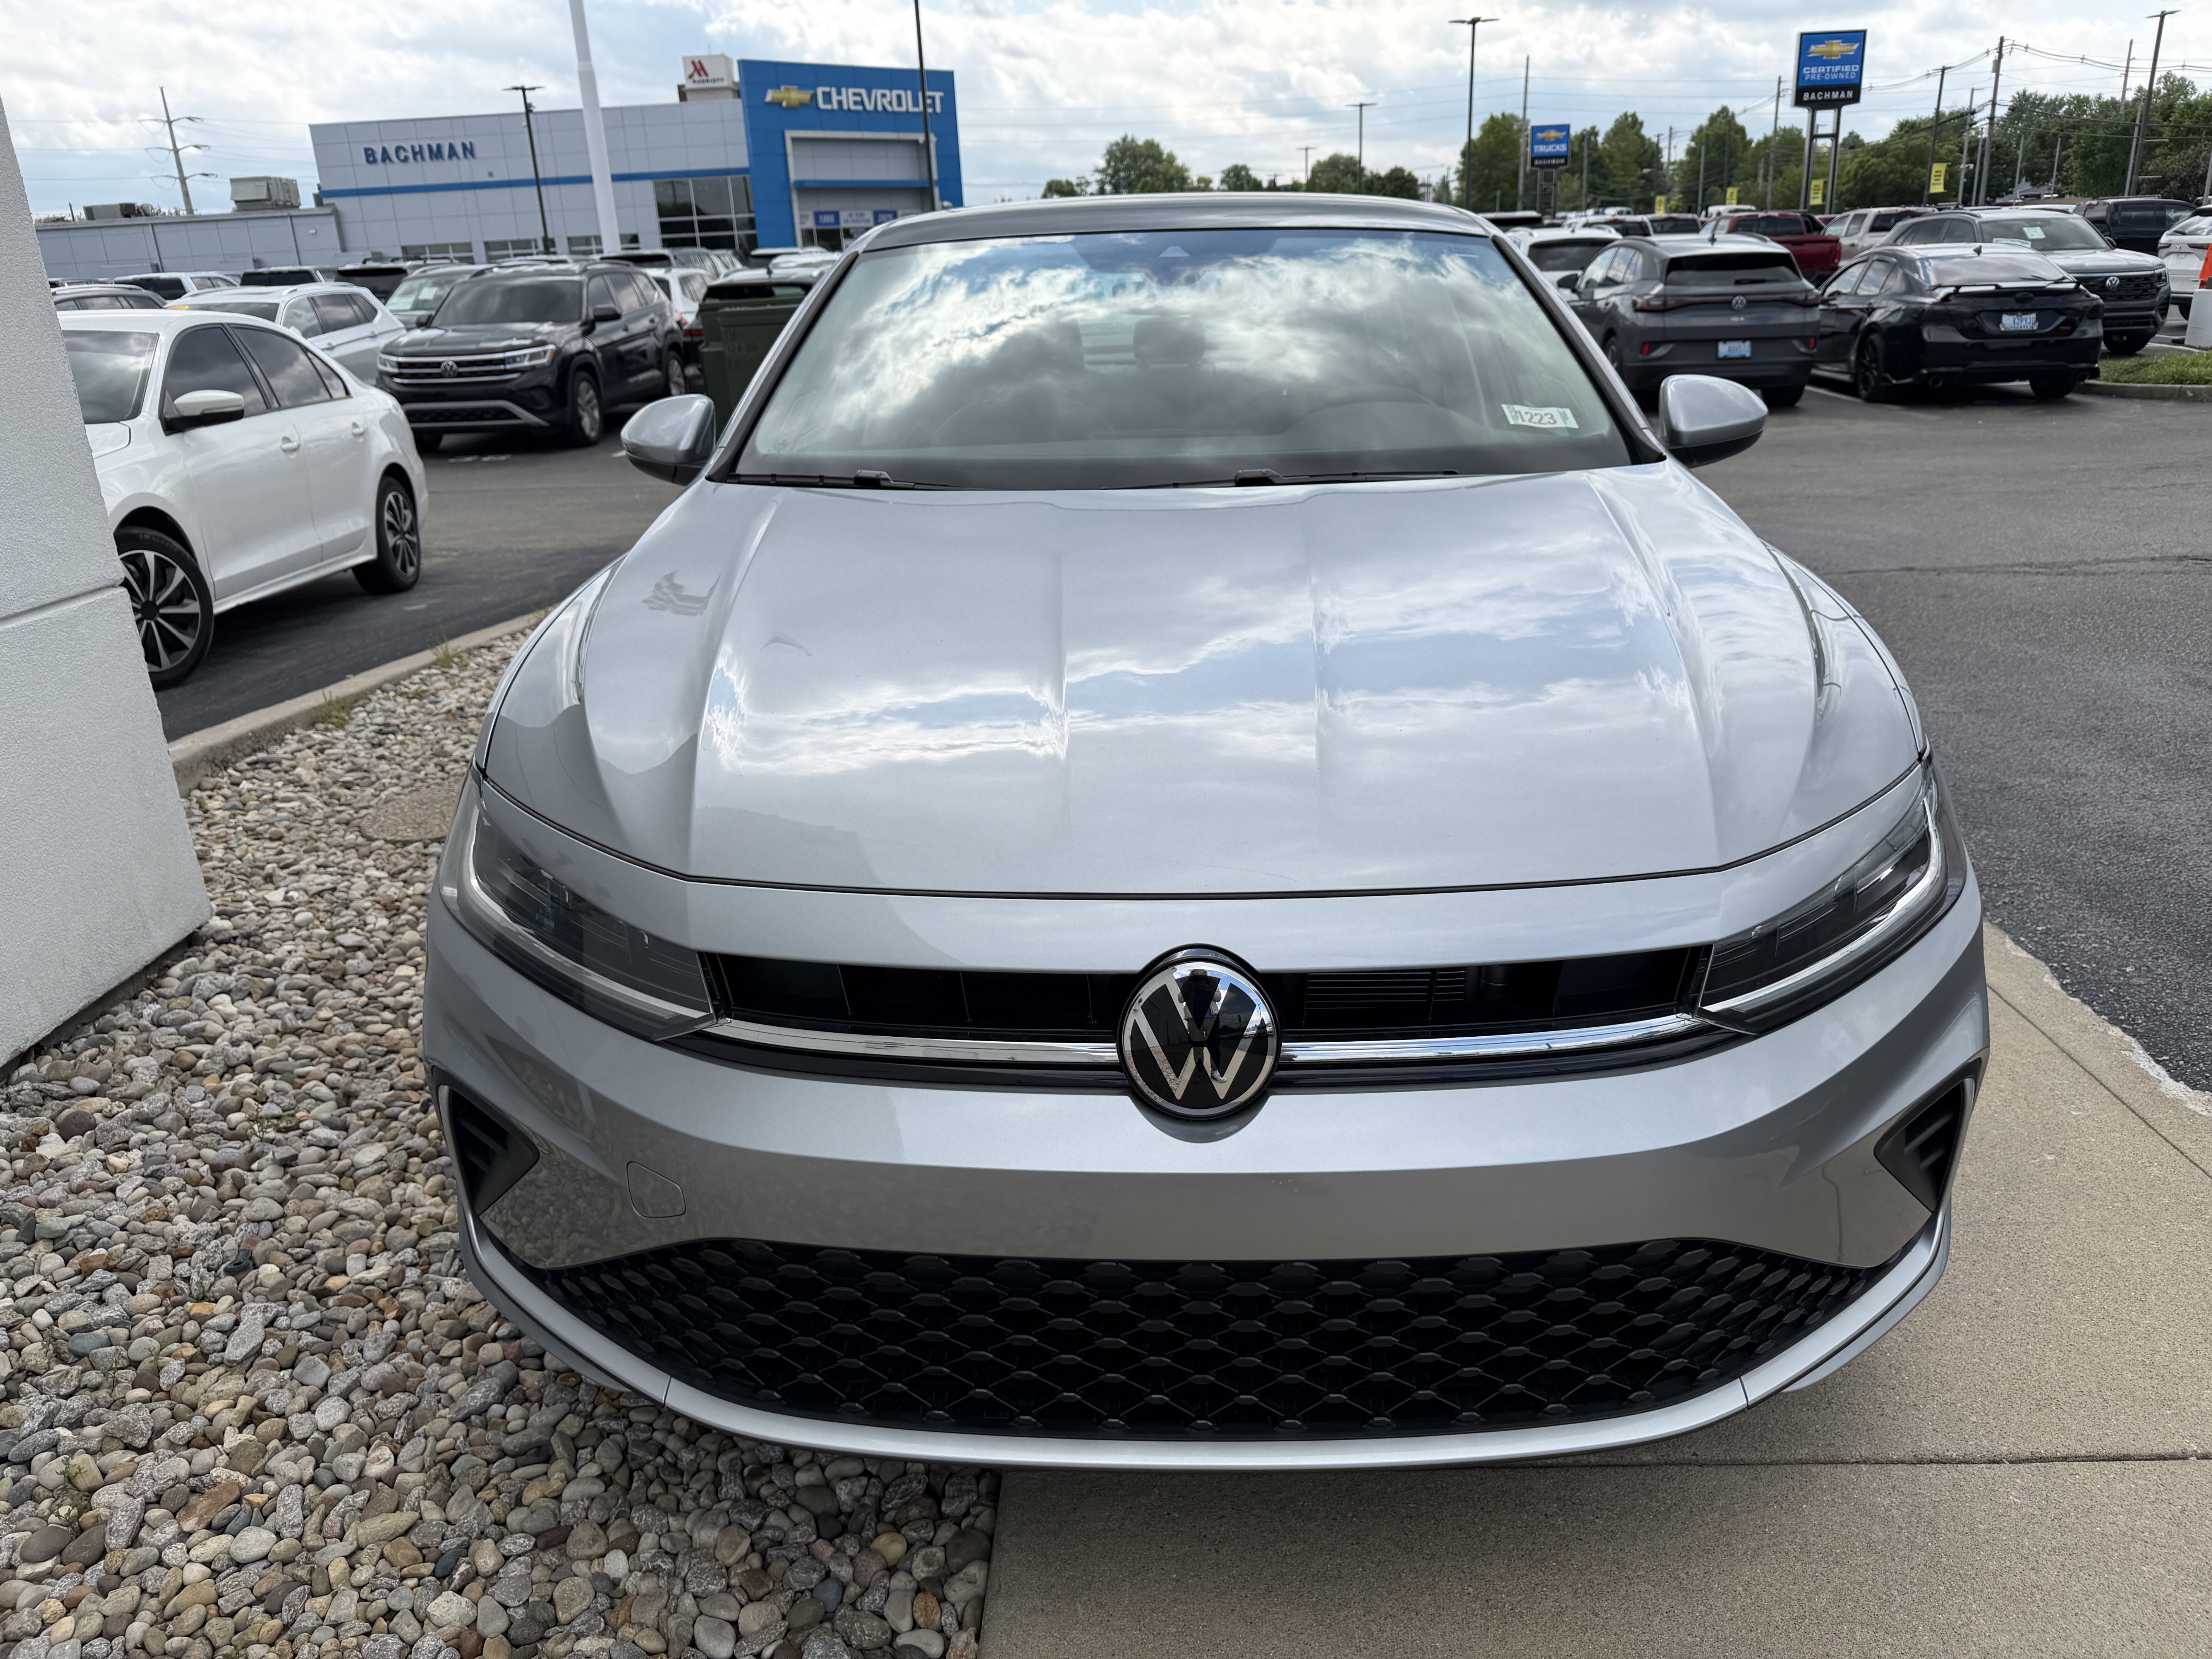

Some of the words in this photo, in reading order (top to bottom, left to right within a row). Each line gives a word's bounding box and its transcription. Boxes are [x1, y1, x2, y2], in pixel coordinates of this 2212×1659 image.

[1803, 64, 1859, 74] CERTIFIED
[1805, 72, 1856, 80] PRE-OWNED
[816, 86, 944, 113] CHEVROLET
[1803, 90, 1853, 101] BACHMAN
[363, 141, 476, 164] BACHMAN
[1516, 410, 1557, 425] 1223
